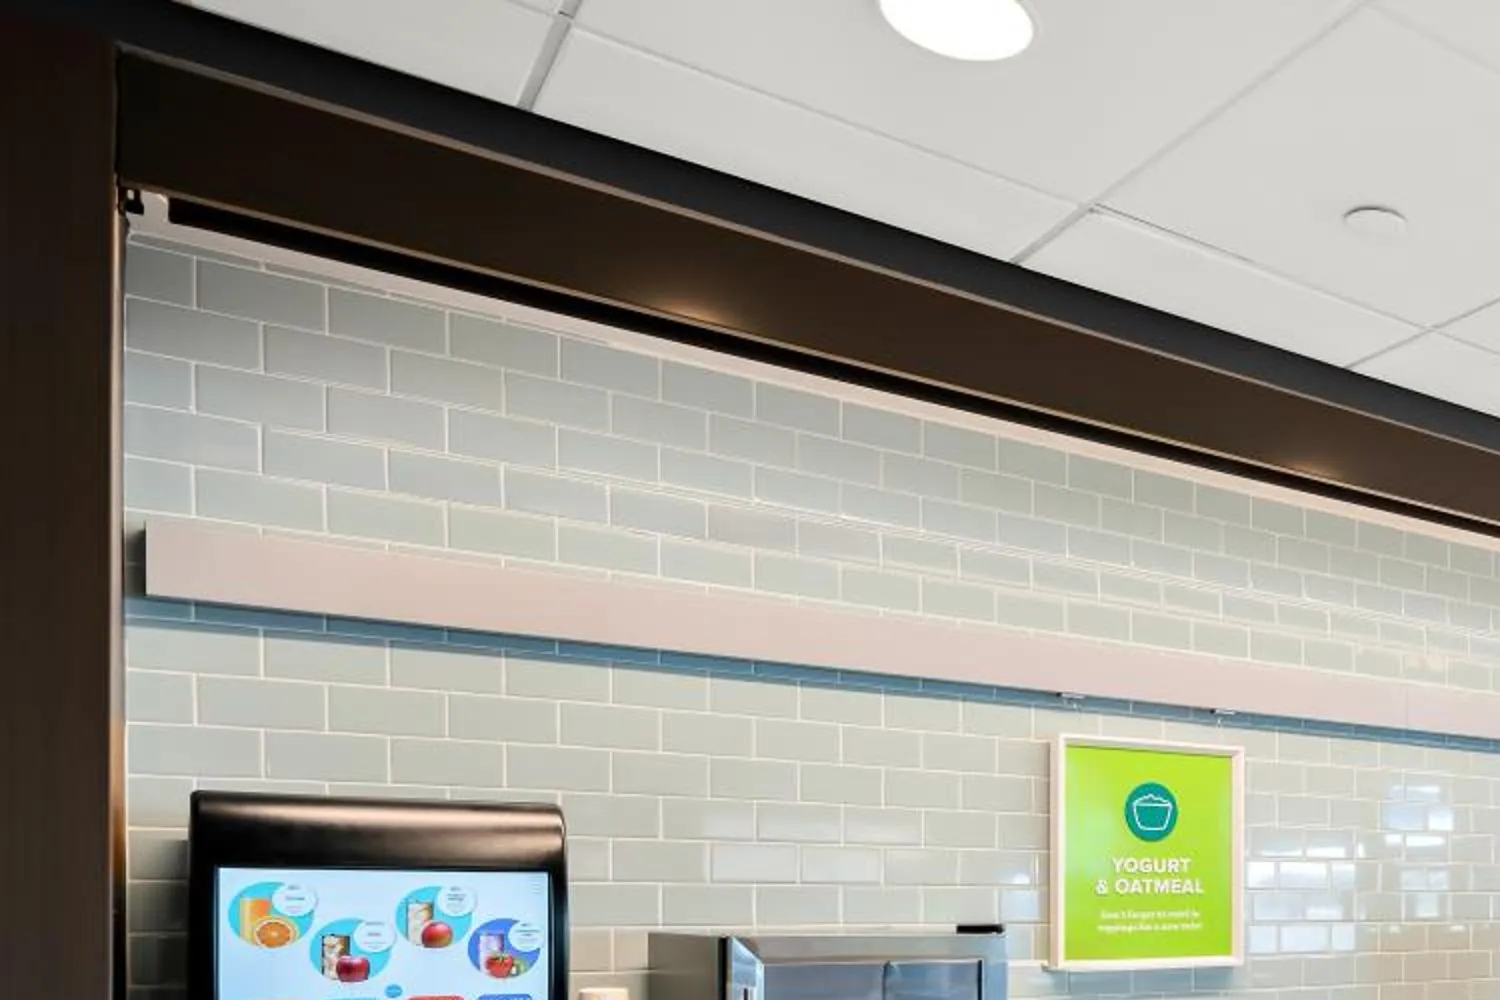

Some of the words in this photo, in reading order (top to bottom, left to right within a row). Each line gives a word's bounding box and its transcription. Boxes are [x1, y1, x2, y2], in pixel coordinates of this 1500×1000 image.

[1112, 857, 1192, 874] YOGURT
[1095, 879, 1109, 895] &
[1115, 878, 1205, 895] OATMEAL
